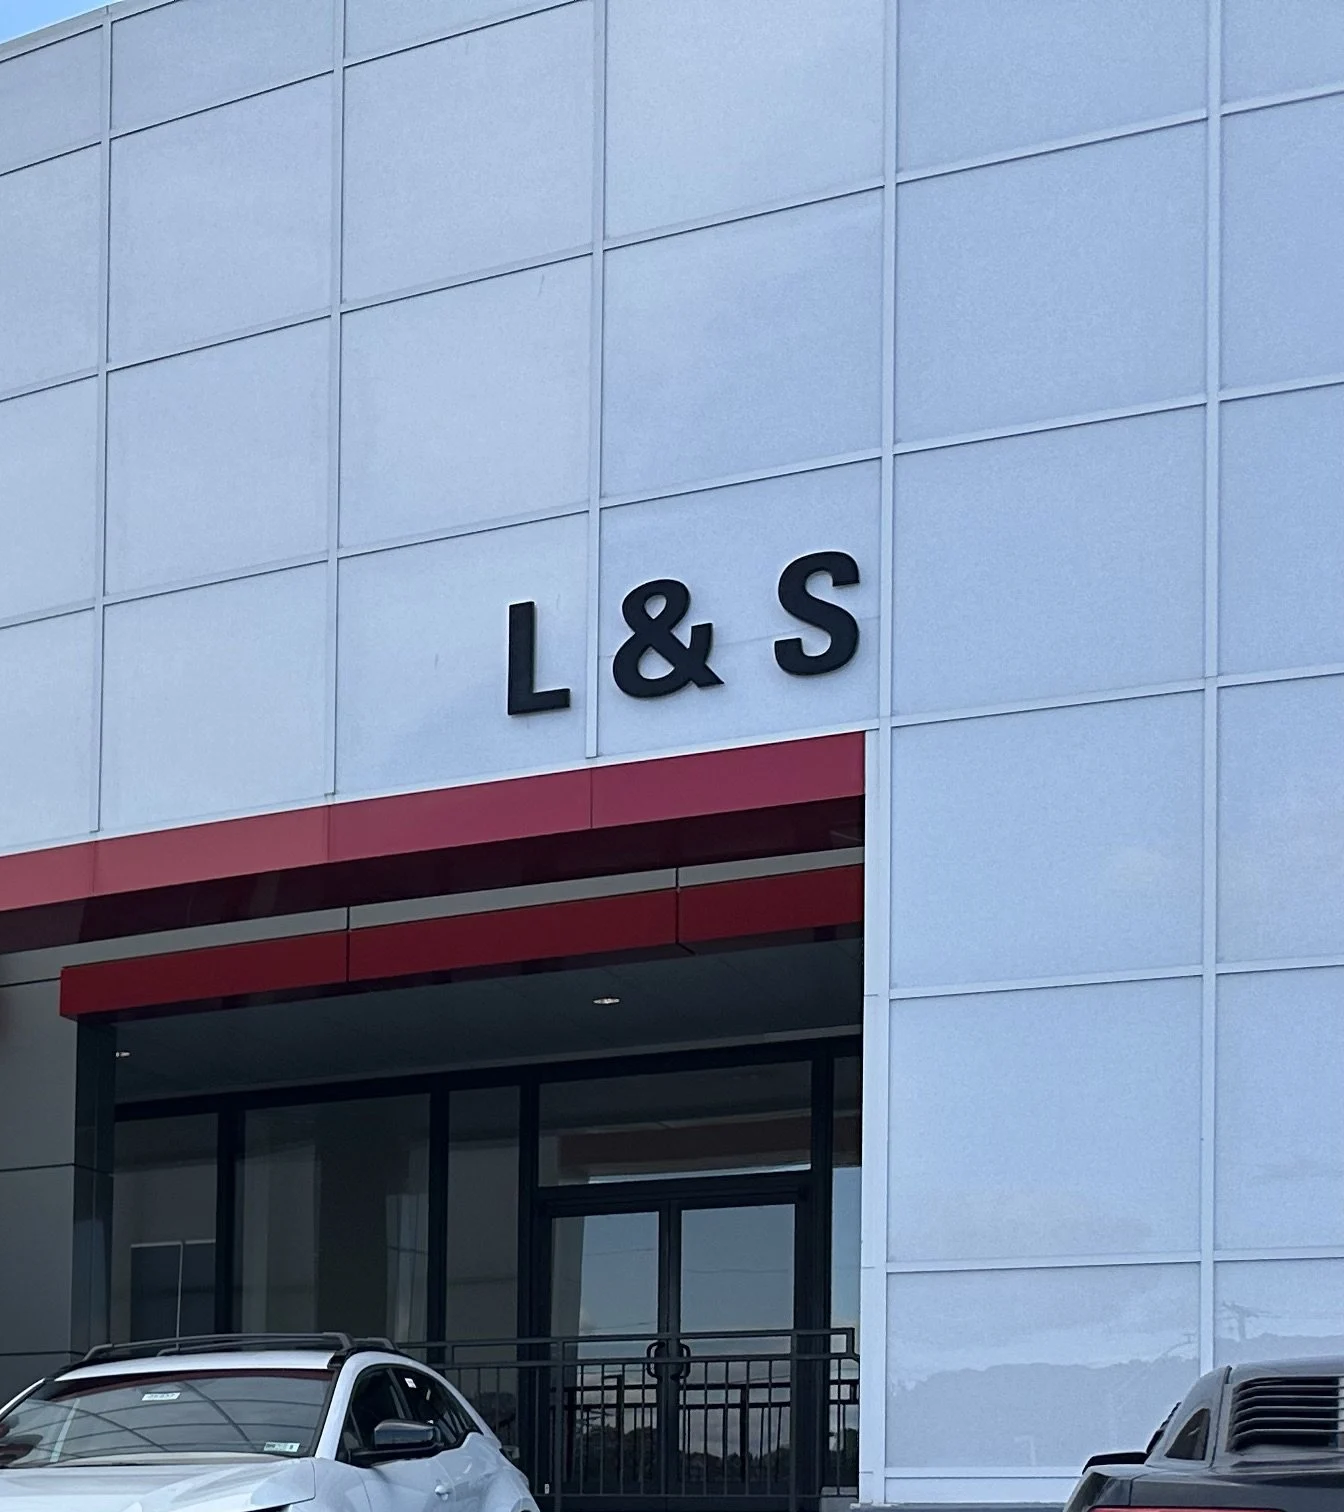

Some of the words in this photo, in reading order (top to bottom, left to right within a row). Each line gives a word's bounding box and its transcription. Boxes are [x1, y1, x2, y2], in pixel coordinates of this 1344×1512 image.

[507, 600, 571, 716] L
[611, 578, 725, 699] &
[773, 550, 861, 676] S
